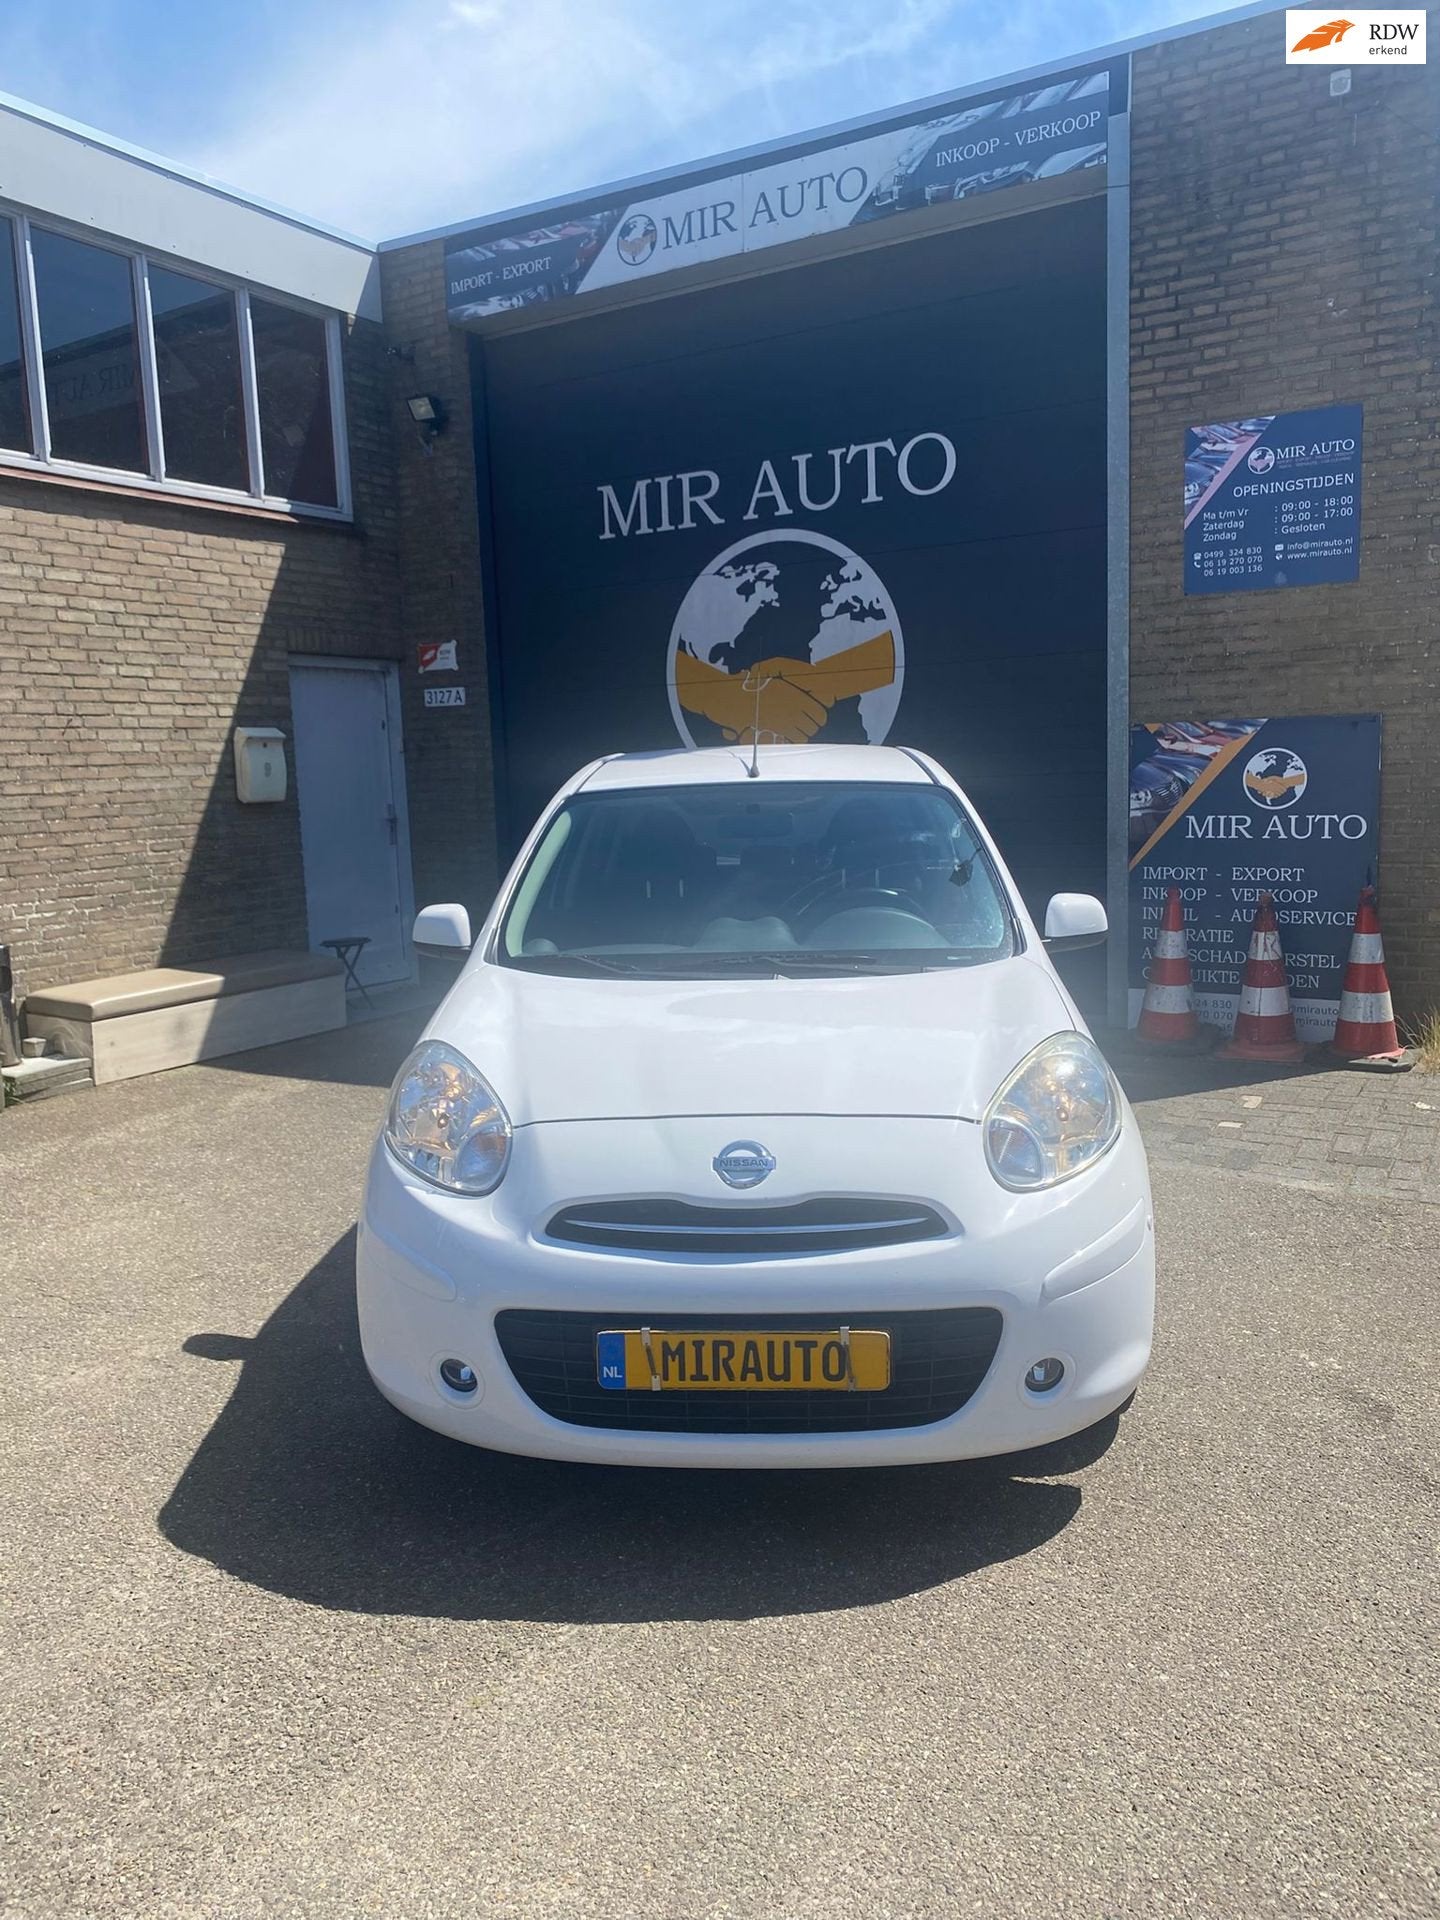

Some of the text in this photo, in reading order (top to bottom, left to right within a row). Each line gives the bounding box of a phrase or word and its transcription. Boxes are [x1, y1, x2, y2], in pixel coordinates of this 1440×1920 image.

[935, 137, 1000, 167] INKOOP
[1014, 110, 1101, 146] VERKOOP
[662, 166, 868, 249] MIR AUTO
[451, 271, 493, 295] IMPORT
[503, 256, 552, 281] EXPORT
[1276, 445, 1307, 460] MIR
[1310, 438, 1355, 456] AUTO
[597, 432, 957, 540] MIR AUTO
[1233, 473, 1354, 497] OPENINGSTIJDEN
[1281, 500, 1311, 511] 09:00
[1324, 495, 1353, 507] 18:00
[1203, 508, 1249, 520] Ma t/m Vr
[1281, 512, 1311, 523] 09:00
[1324, 507, 1353, 518] 17:00
[1203, 520, 1245, 531] Zaterdag
[1281, 522, 1326, 534] Gesloten
[1203, 532, 1237, 542] Zondag
[1287, 537, 1353, 550] info@mirauto.nl
[1203, 546, 1262, 559] 0499 324 830
[1287, 546, 1352, 559] www.mirauto.nl
[1203, 555, 1262, 568] 06 19 270 070
[1229, 566, 1244, 574] 003
[1248, 564, 1262, 572] 136
[427, 689, 462, 705] 3127 A
[1185, 814, 1367, 840] MIR AUTO
[1143, 866, 1208, 880] IMPORT
[1232, 867, 1305, 881] EXPORT
[1143, 887, 1207, 901] INKOP
[1143, 907, 1199, 921] INIL
[1230, 908, 1357, 925] AUSERVICE
[1143, 927, 1234, 943] RRATIE
[1212, 1000, 1232, 1009] 830
[1213, 1011, 1233, 1020] 070
[719, 1158, 768, 1167] NISSAN
[661, 1340, 847, 1382] MIRAUTO
[603, 1366, 622, 1378] NL
